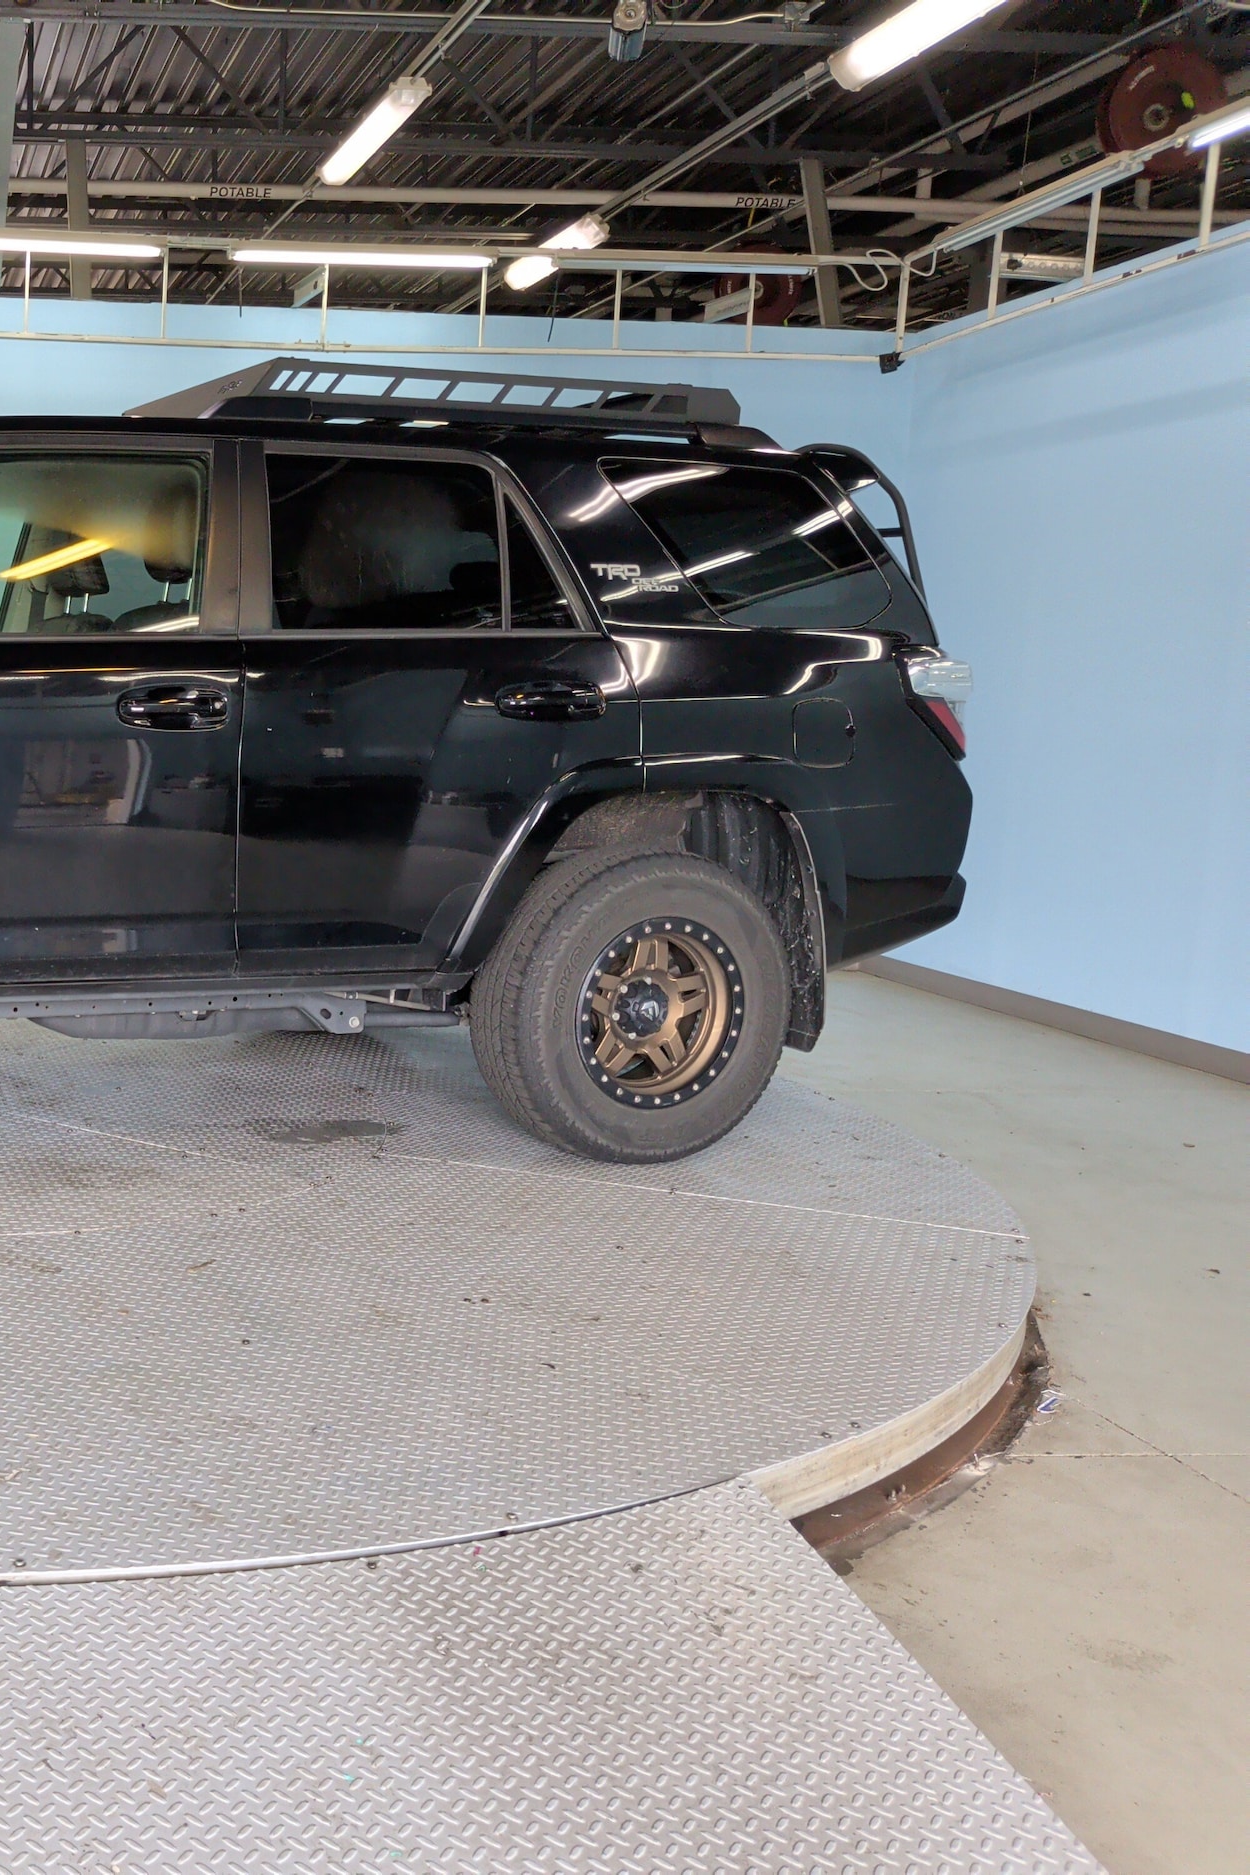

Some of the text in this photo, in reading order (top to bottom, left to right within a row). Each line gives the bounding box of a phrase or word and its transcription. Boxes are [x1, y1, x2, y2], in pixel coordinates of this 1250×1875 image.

[210, 186, 272, 198] POTABLE
[590, 564, 641, 580] TRD
[638, 584, 679, 593] ROAD
